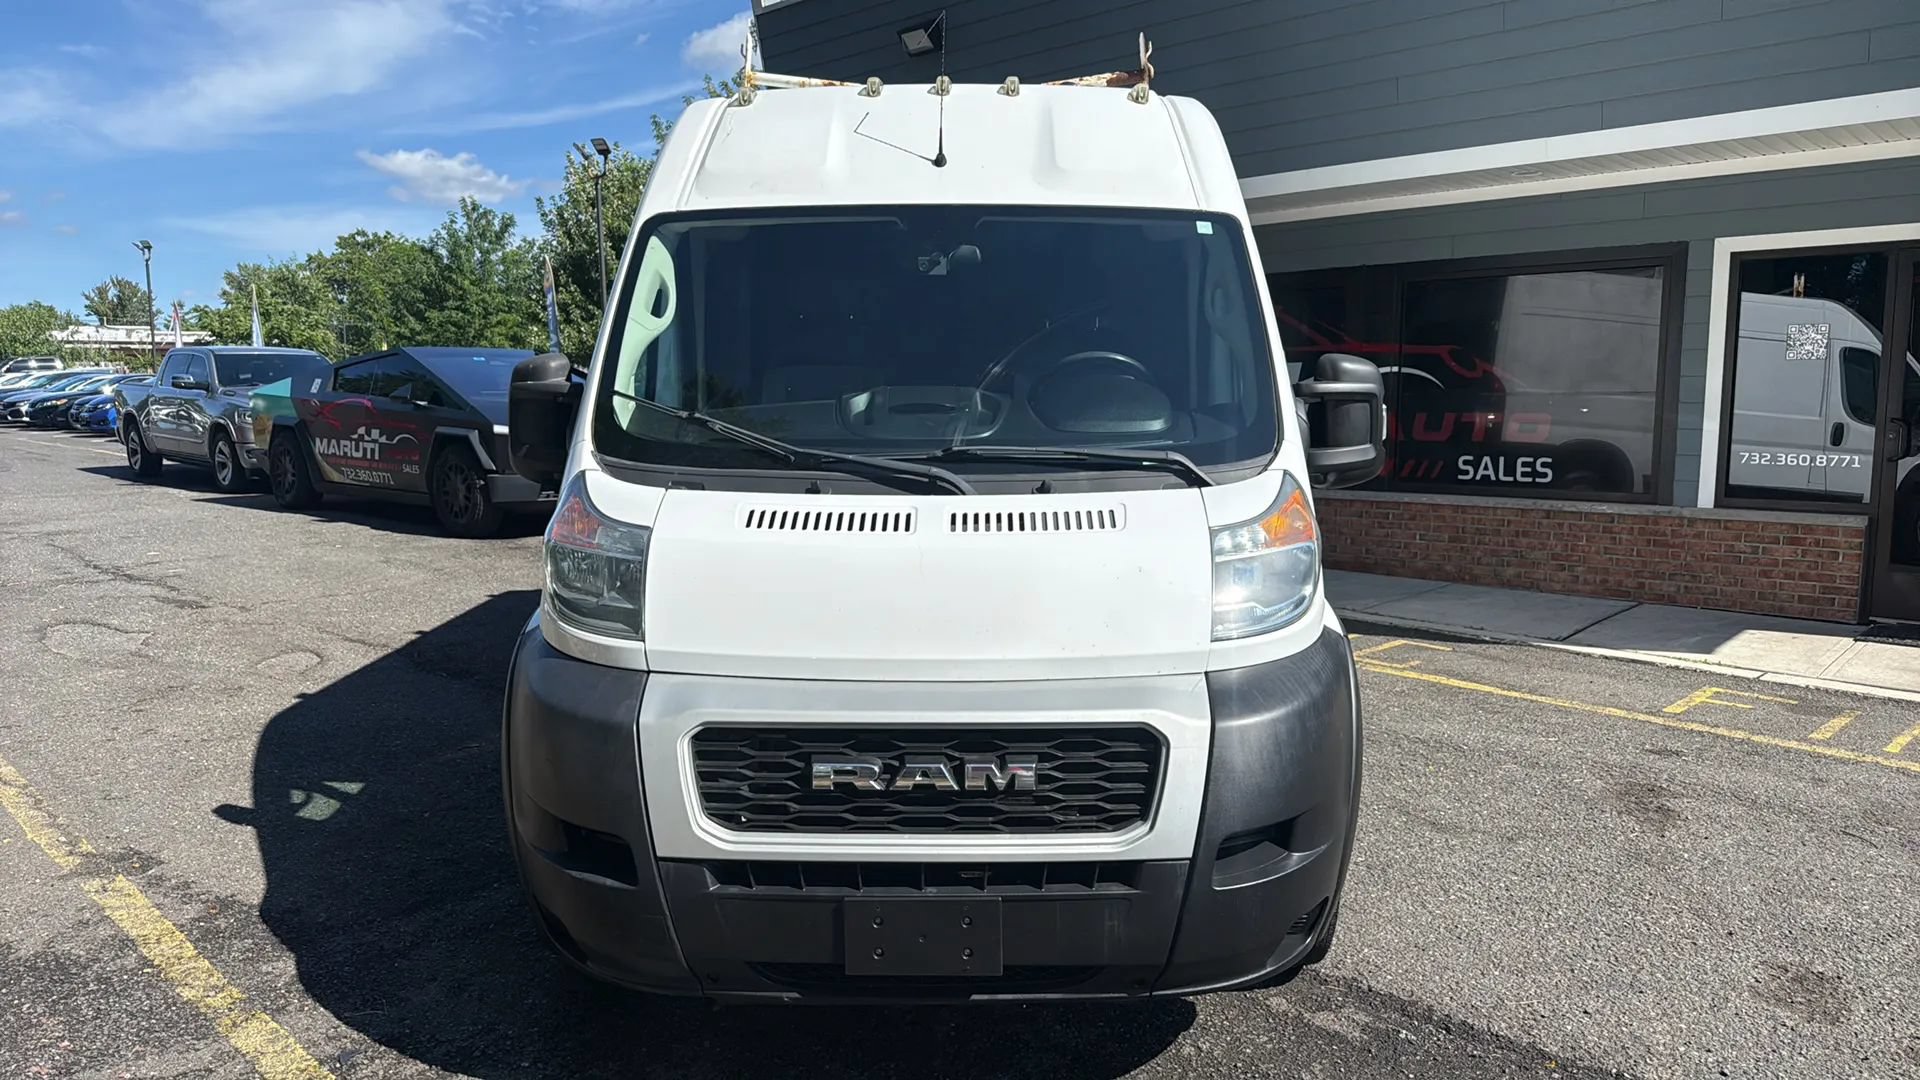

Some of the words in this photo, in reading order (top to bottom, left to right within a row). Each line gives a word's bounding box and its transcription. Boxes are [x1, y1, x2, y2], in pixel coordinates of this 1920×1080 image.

[315, 438, 379, 460] MARUTI
[1739, 452, 1861, 468] 732.360.8771
[402, 463, 420, 474] SALES
[1457, 455, 1553, 483] SALES
[811, 754, 1039, 791] RAM
